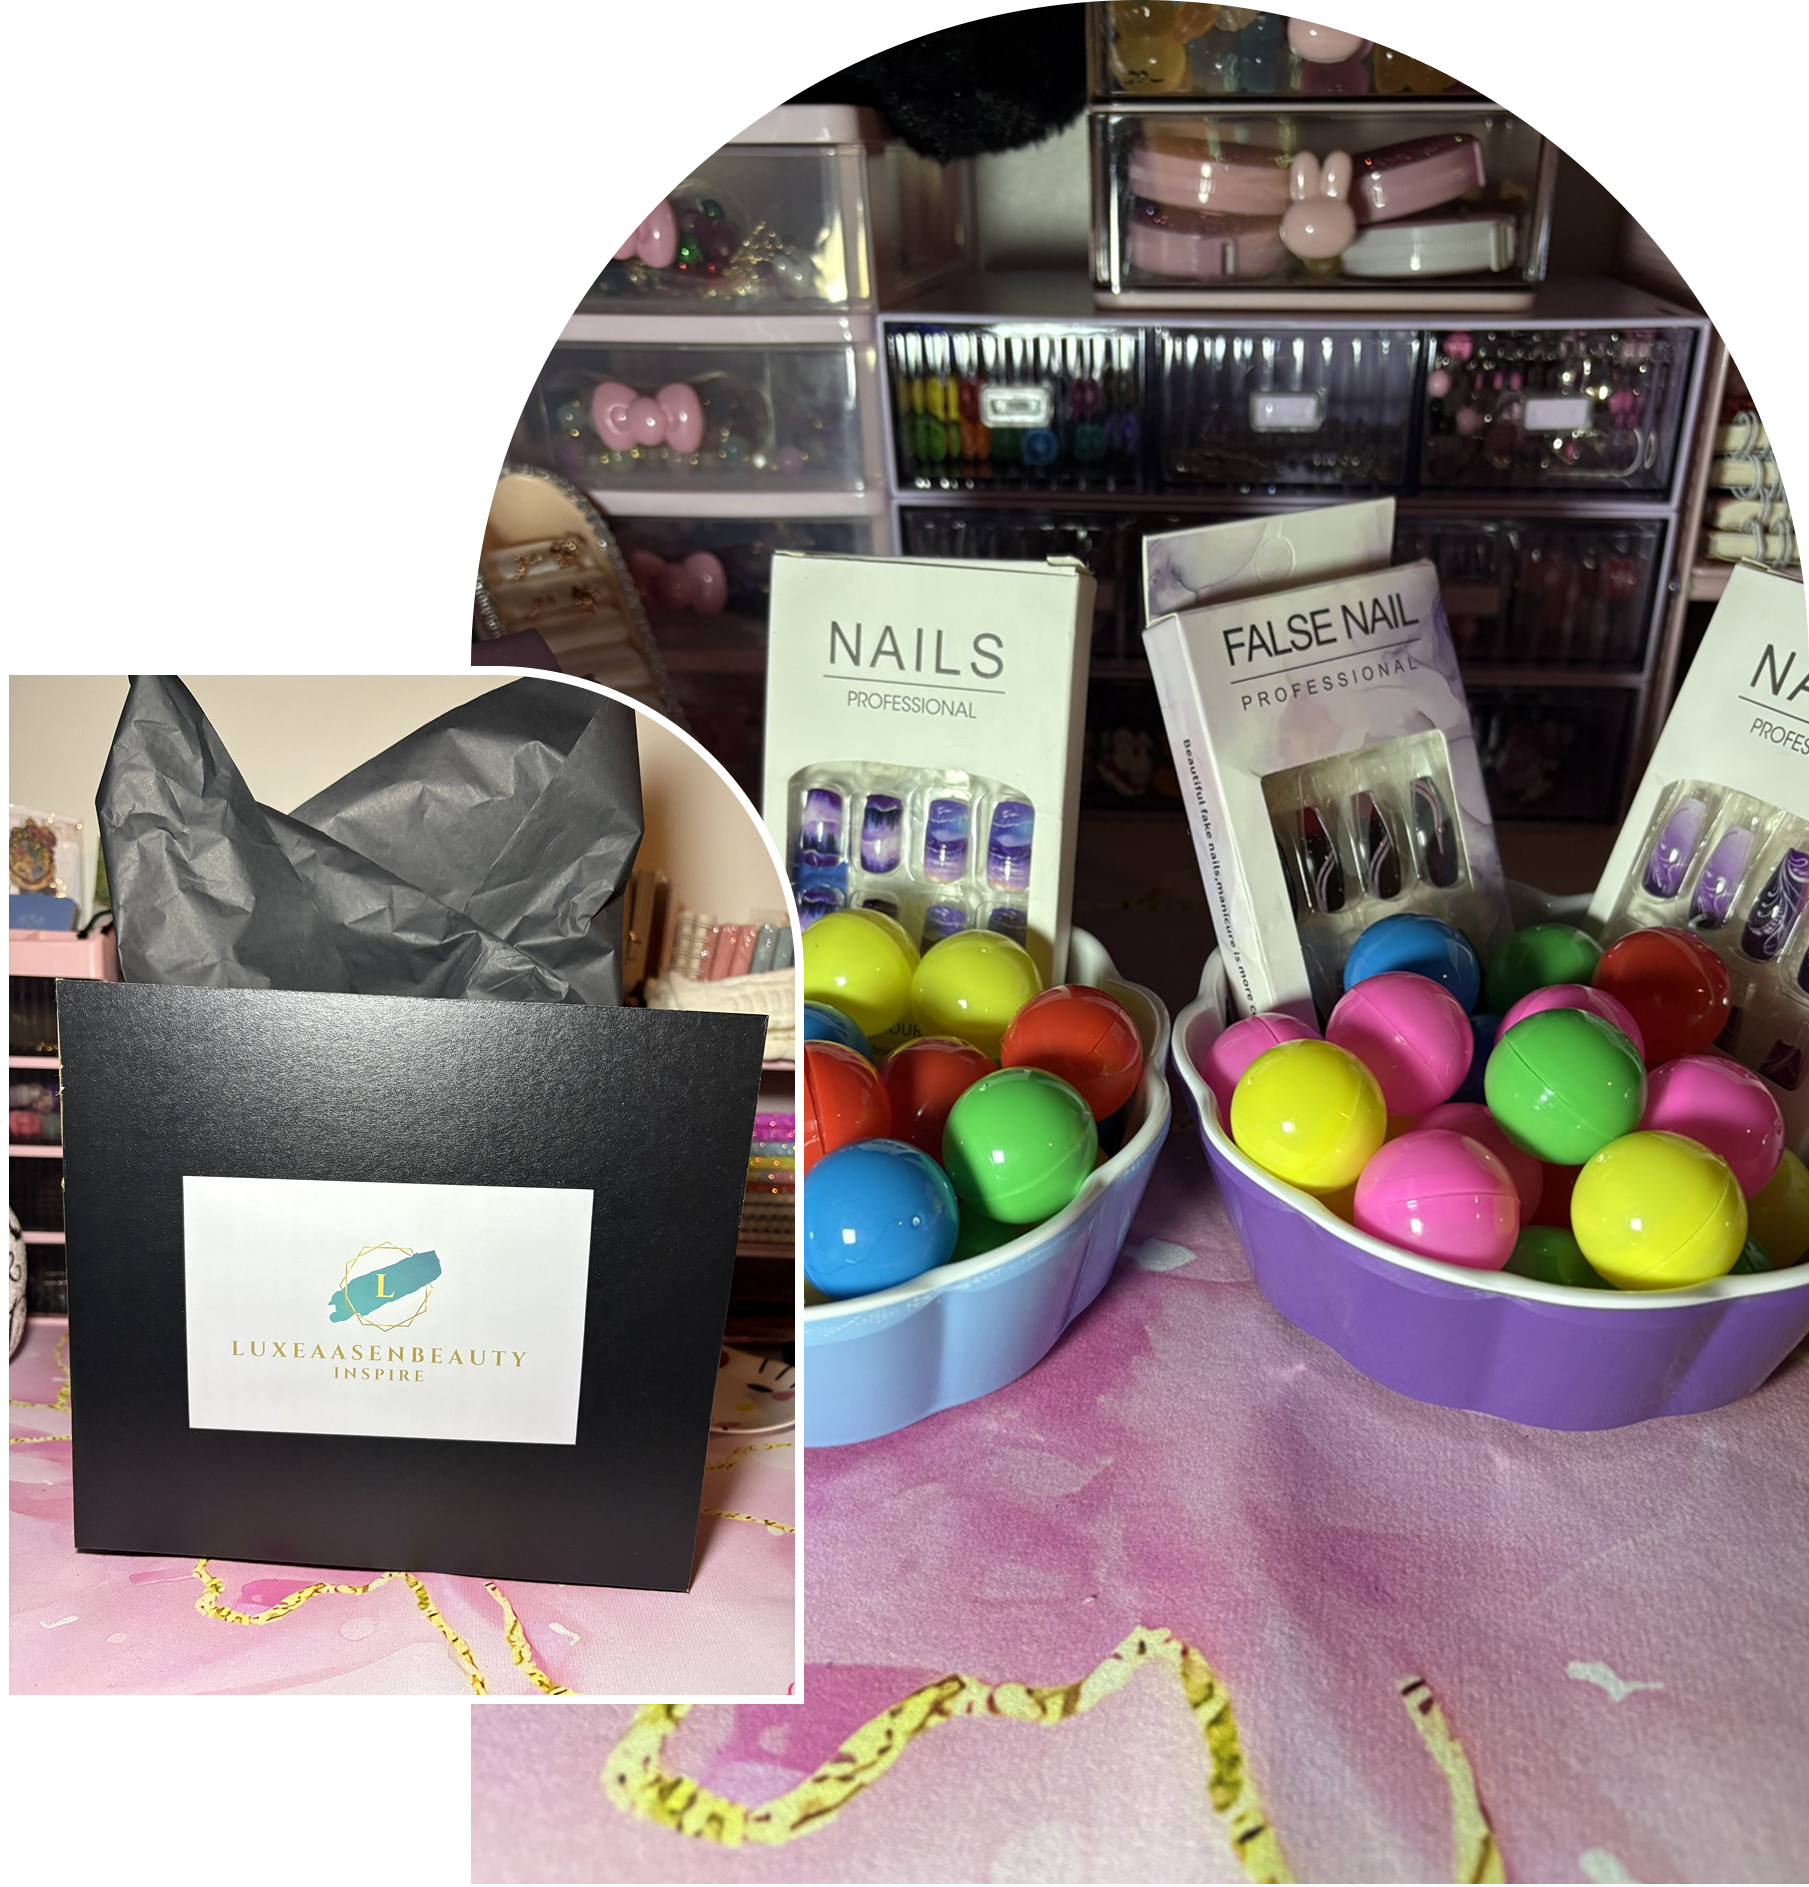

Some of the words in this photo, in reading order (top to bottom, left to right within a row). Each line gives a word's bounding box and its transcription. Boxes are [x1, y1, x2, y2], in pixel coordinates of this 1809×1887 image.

[829, 620, 1005, 679] NAILS
[1222, 607, 1338, 667] FALSE
[1340, 592, 1420, 641] NAIL
[846, 690, 978, 719] PROFESSIONAL
[1241, 656, 1419, 711] PROFESSIONAL
[1182, 738, 1206, 806] Beautiful
[1200, 808, 1213, 840] fake
[1233, 951, 1242, 963] is
[1238, 965, 1254, 1002] more
[375, 1273, 396, 1299] L
[231, 1339, 529, 1368] LUXEAASENBEAUTY
[333, 1366, 425, 1383] INSPIRE
